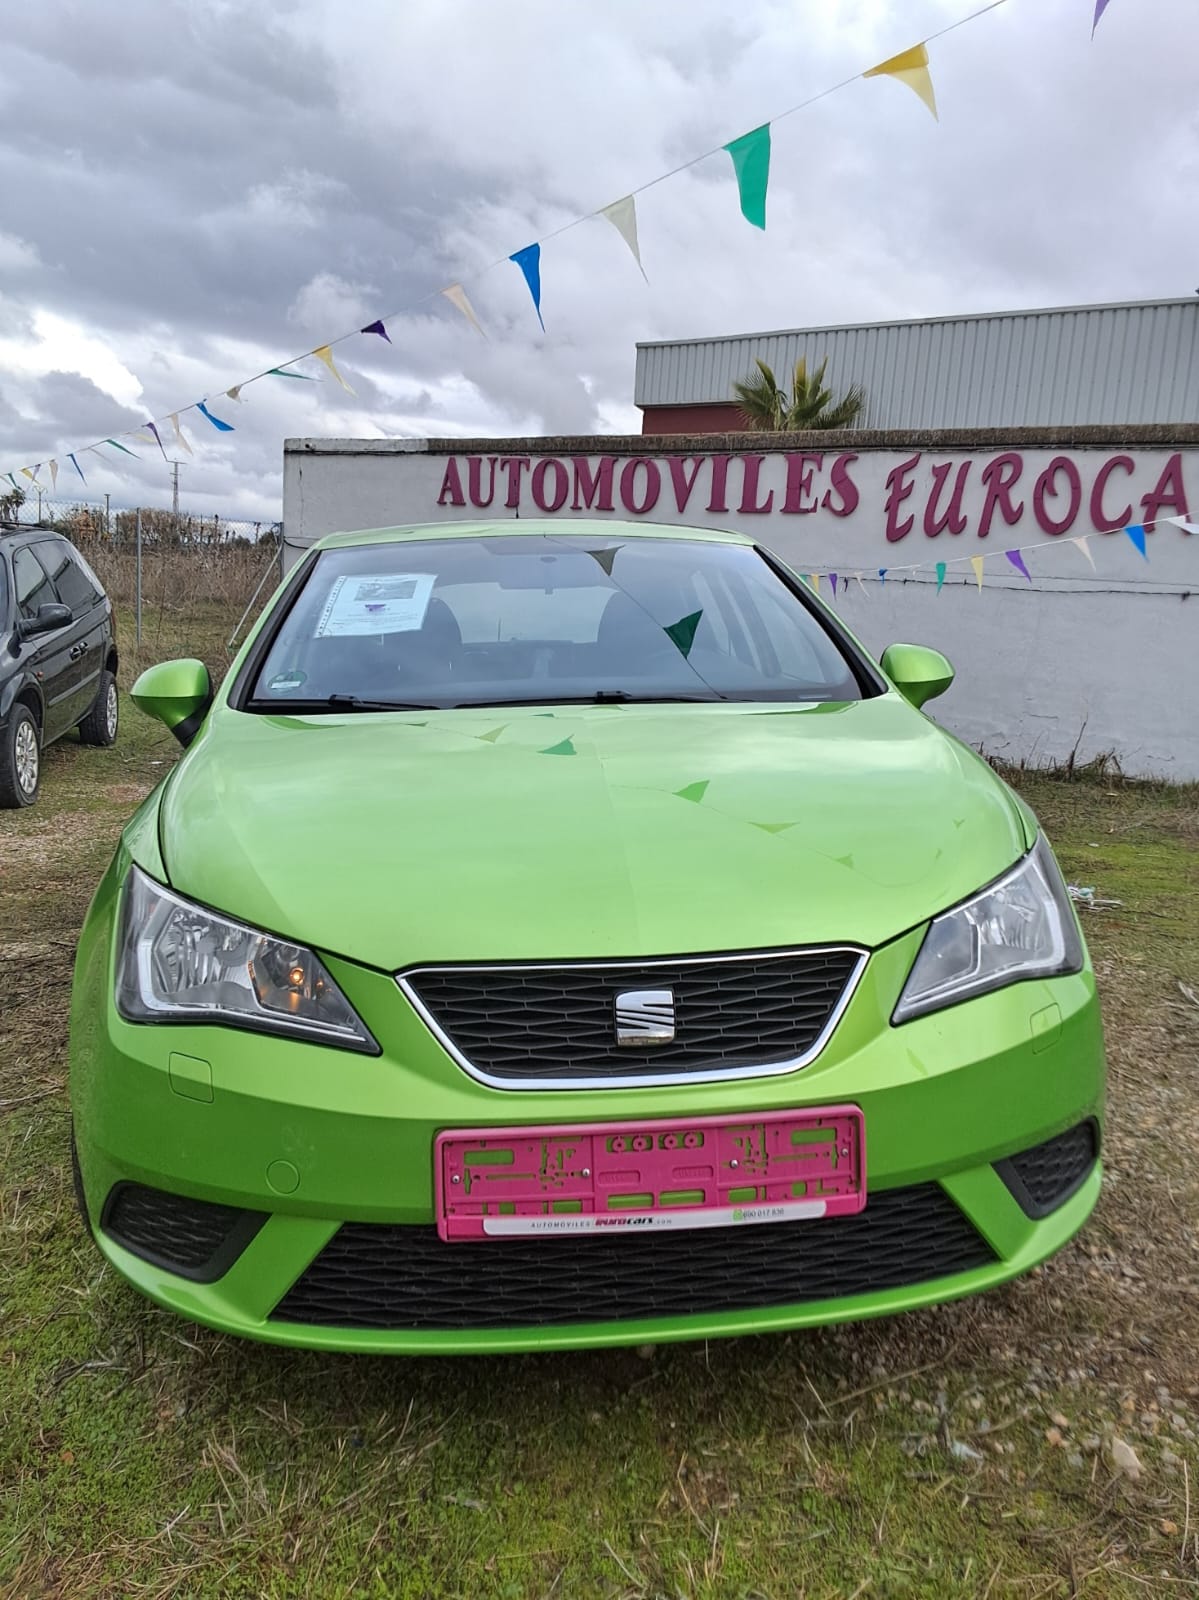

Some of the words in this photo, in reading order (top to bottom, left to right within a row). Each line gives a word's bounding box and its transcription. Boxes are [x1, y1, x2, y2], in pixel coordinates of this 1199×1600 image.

[437, 455, 859, 517] AUTOMOVILES
[884, 452, 1194, 542] EUROCA
[531, 1219, 590, 1228] AUTOMOVILES
